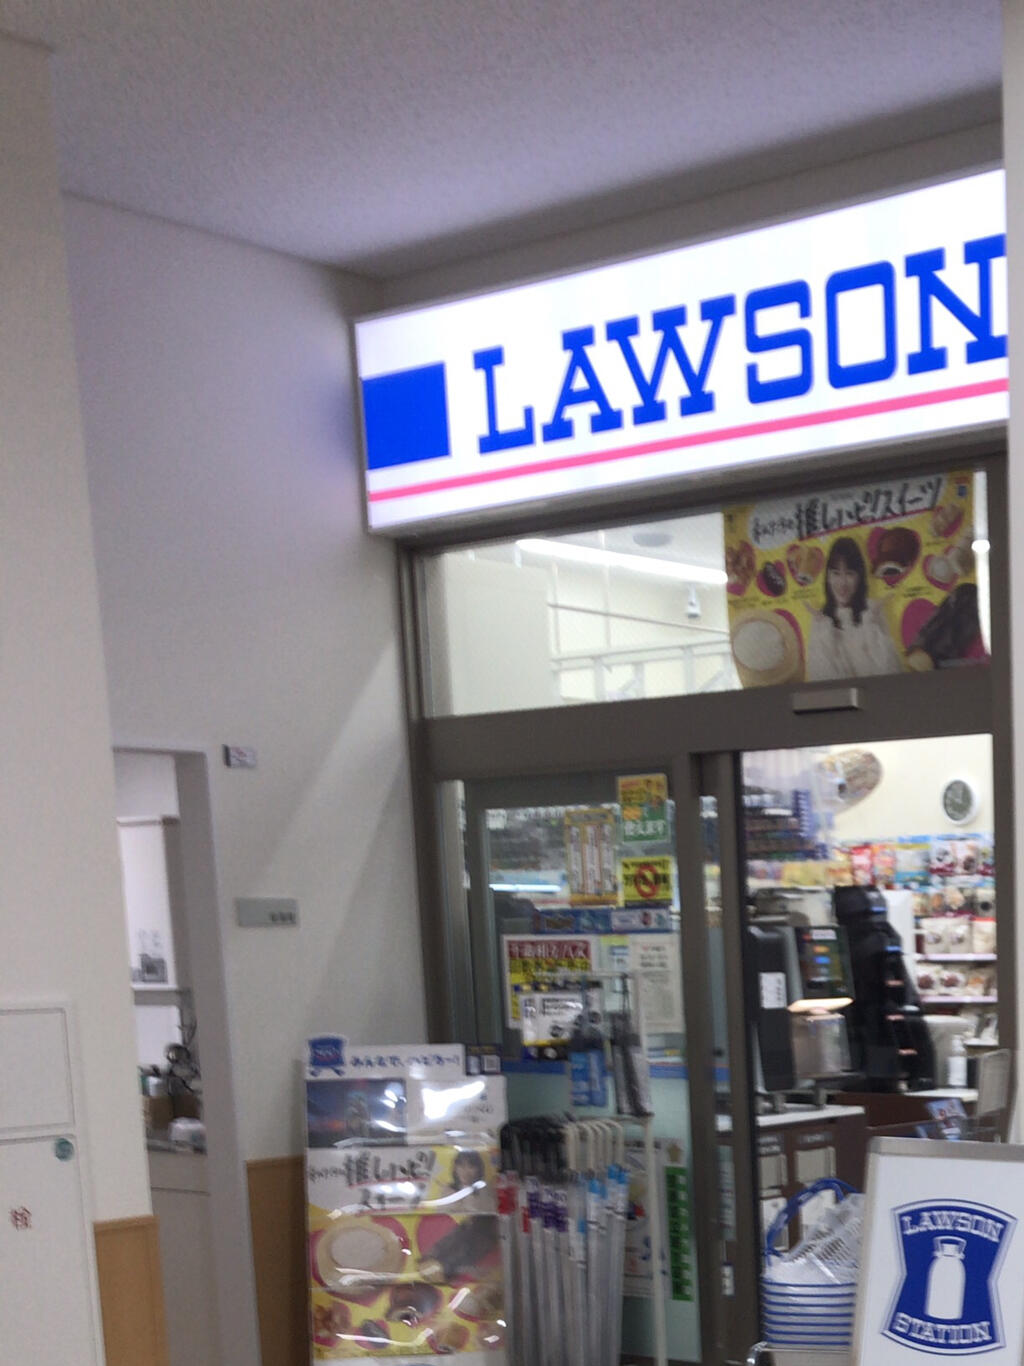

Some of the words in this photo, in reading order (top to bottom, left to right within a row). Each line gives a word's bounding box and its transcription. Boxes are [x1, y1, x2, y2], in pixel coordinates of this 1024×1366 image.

[473, 233, 1008, 455] LAWSON
[901, 1210, 1004, 1243] LAWSON
[892, 1312, 993, 1344] STATION
